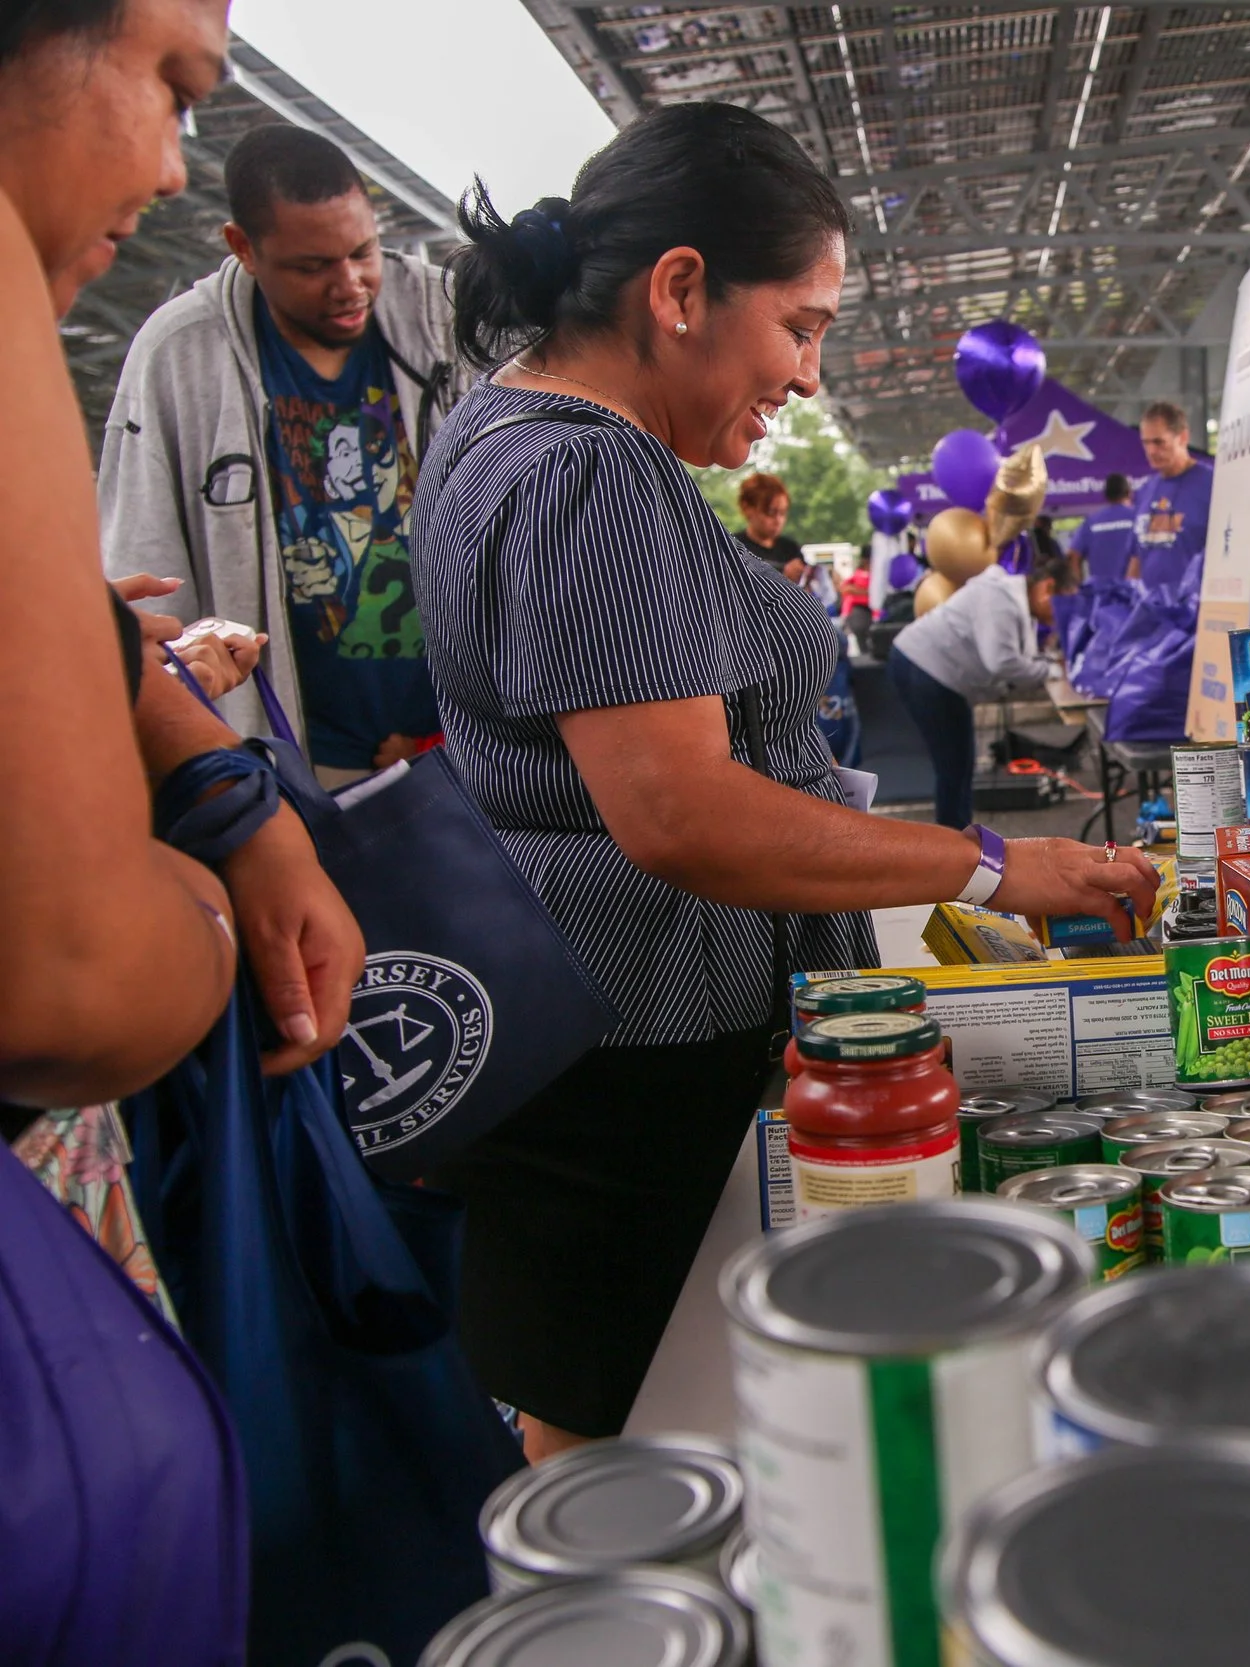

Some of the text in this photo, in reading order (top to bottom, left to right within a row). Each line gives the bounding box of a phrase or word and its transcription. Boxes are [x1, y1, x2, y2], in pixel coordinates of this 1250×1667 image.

[1069, 922, 1112, 933] SPAGHETT
[352, 963, 452, 992] RSEY
[1210, 969, 1228, 981] Del
[1226, 982, 1249, 991] Quality
[1207, 1013, 1246, 1027] SWEET
[400, 1007, 482, 1133] SERVICES
